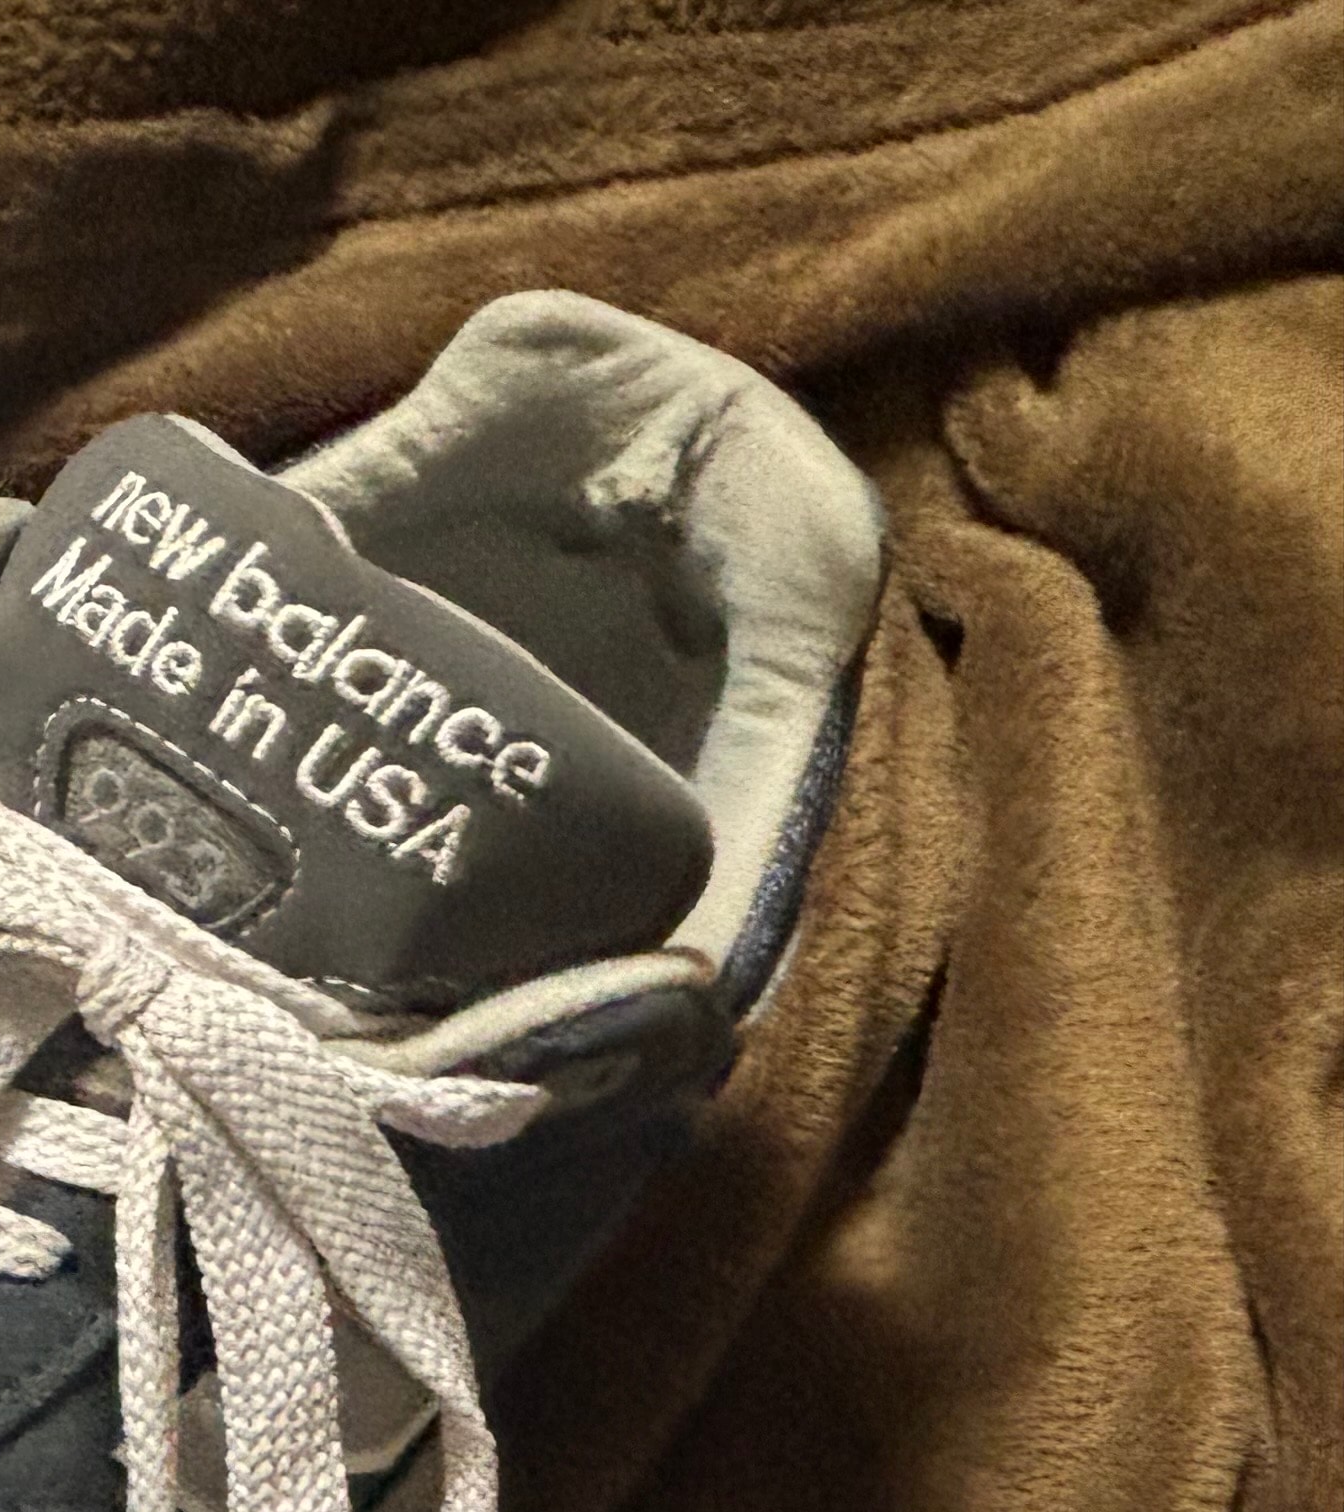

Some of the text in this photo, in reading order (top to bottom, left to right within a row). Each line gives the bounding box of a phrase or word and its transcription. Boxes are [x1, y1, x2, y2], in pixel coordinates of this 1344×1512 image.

[31, 537, 471, 886] Made in USA
[92, 471, 551, 801] new balance
